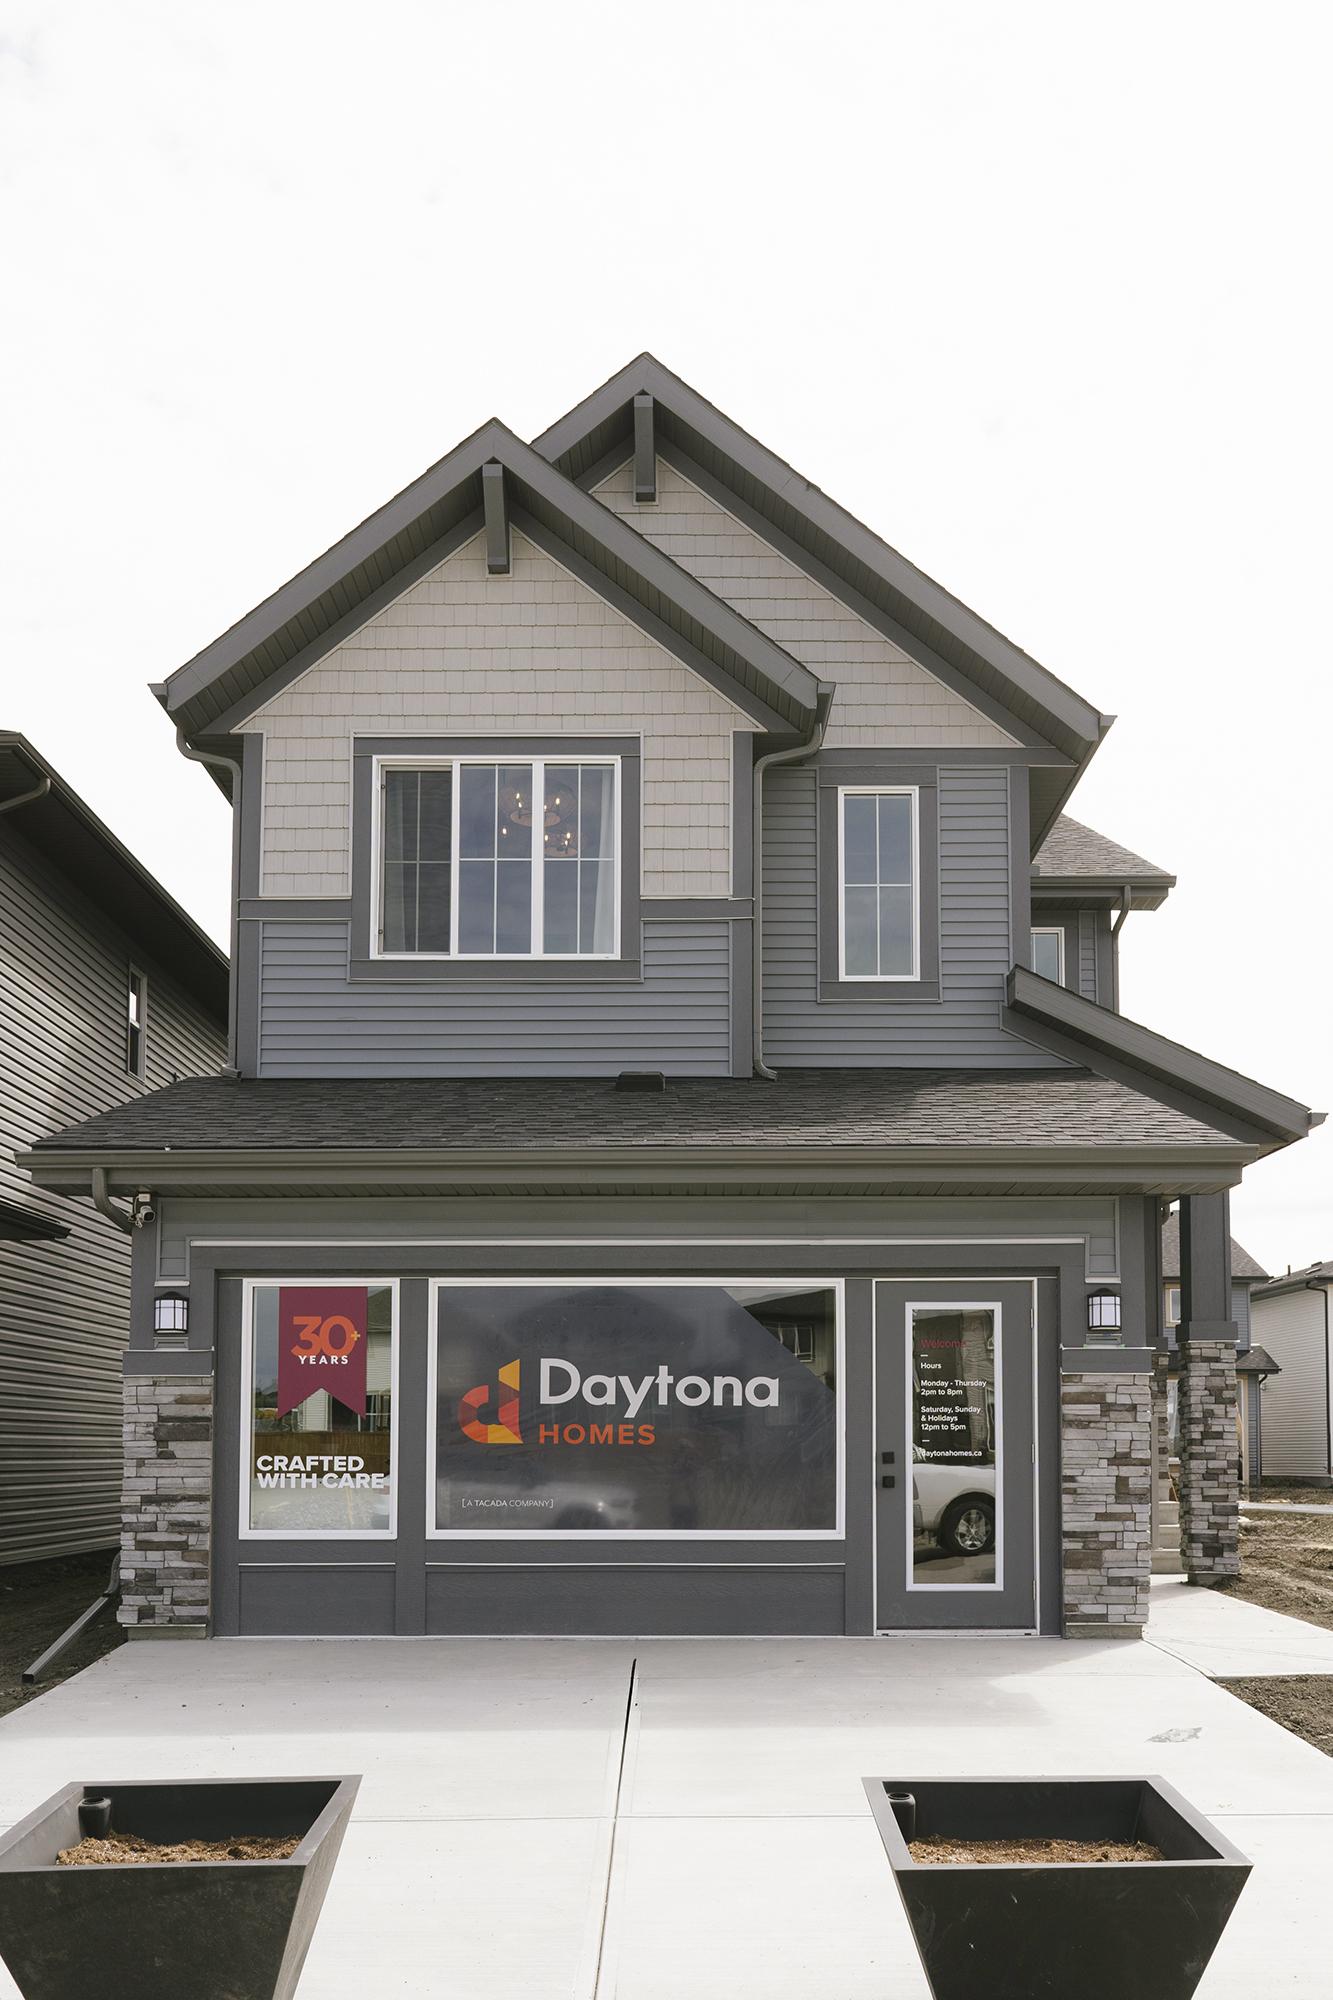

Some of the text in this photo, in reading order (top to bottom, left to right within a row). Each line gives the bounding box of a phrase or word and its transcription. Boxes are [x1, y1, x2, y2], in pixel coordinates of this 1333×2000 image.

[921, 1339, 967, 1348] Welcome
[298, 1355, 349, 1365] YEARS
[540, 1358, 780, 1418] Daytona
[920, 1380, 949, 1388] Monday
[954, 1380, 987, 1388] Thursday
[920, 1388, 937, 1396] 2pm
[946, 1388, 963, 1396] 8pm
[920, 1406, 981, 1414] Saturday, Sunday
[928, 1414, 958, 1422] Holidays
[539, 1423, 656, 1446] HOMES
[921, 1450, 983, 1458] daytonahomes.ca
[256, 1455, 365, 1472] CRAFTED
[256, 1473, 385, 1489] WITH CARE
[474, 1499, 508, 1507] TACADA
